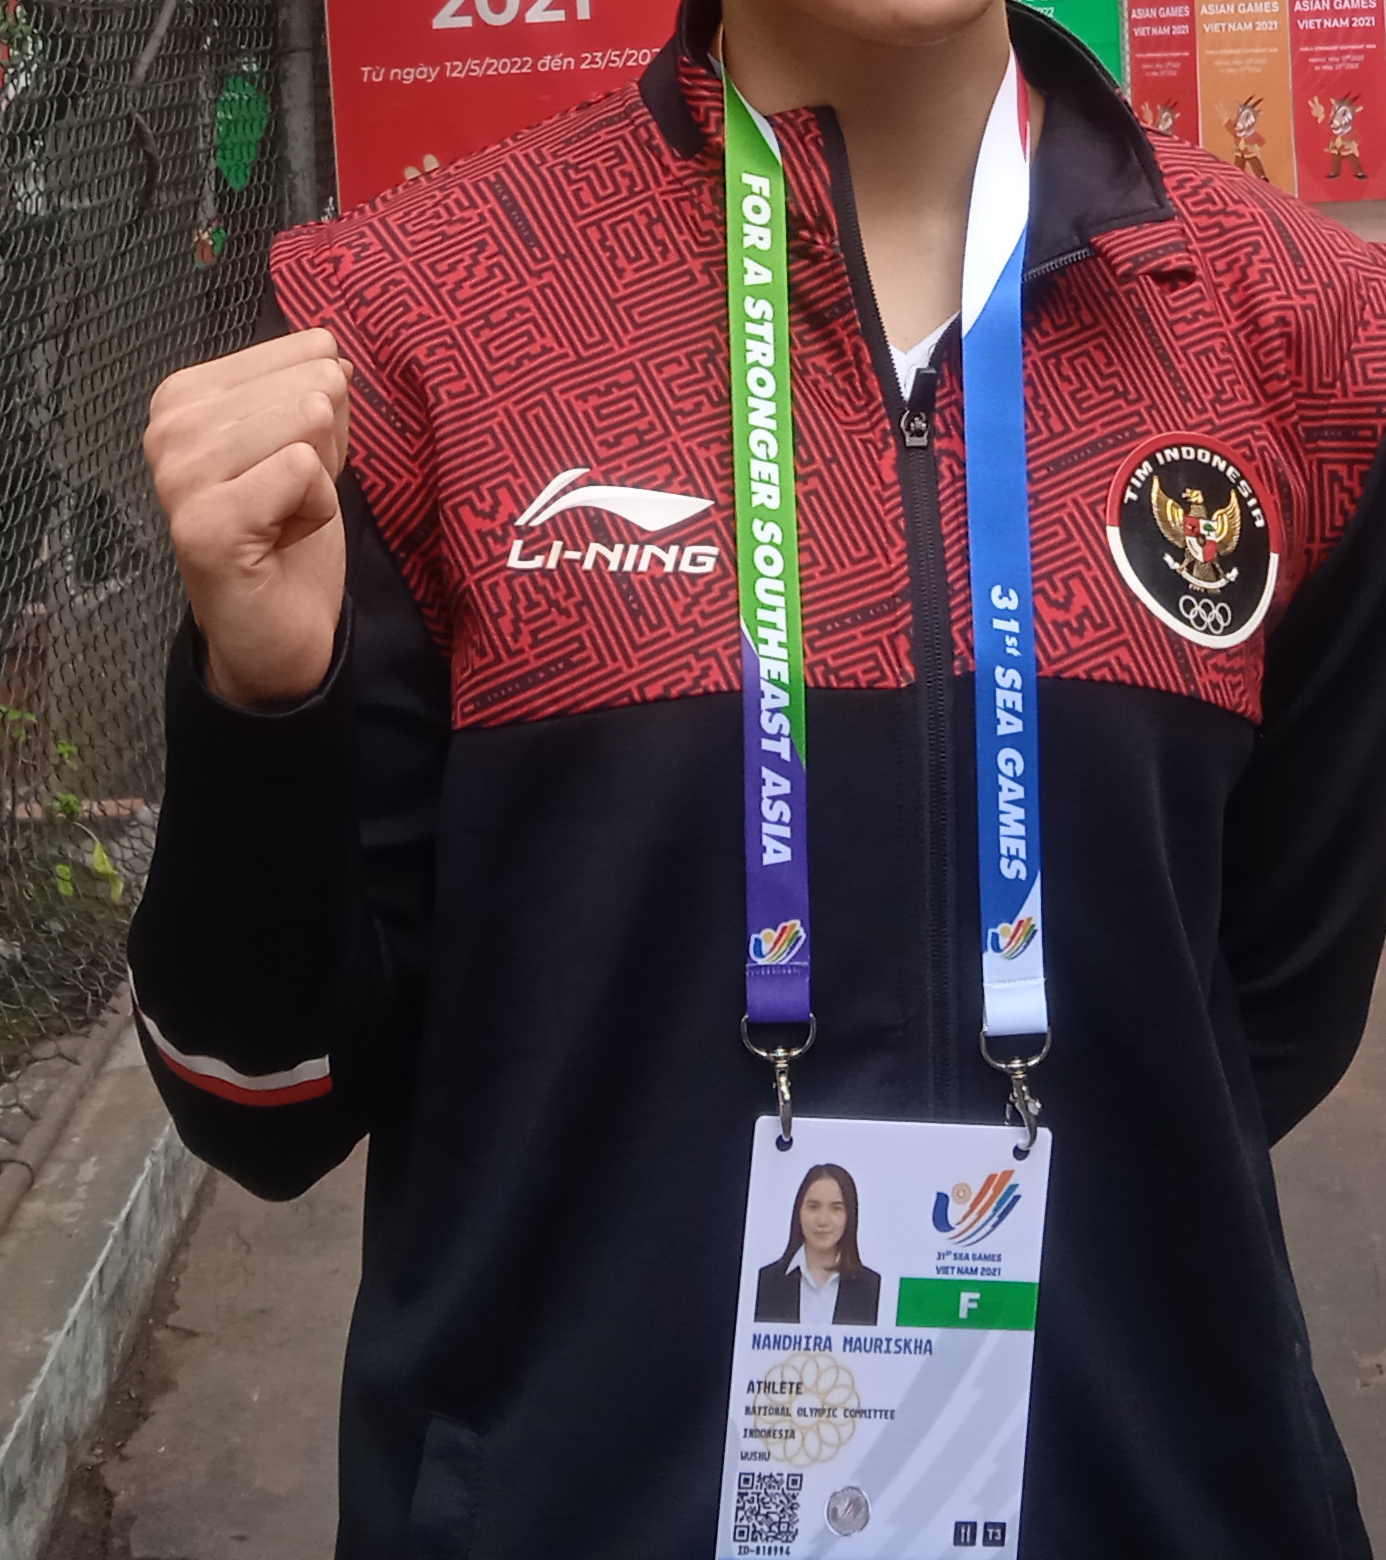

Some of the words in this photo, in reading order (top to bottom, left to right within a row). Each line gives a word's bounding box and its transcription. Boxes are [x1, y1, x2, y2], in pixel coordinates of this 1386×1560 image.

[1131, 7, 1157, 19] ASIAN
[1158, 5, 1190, 18] GAMES
[1200, 3, 1235, 15] ASIAN
[1237, 1, 1279, 14] GAMES
[1294, 0, 1330, 12] ASIAN
[1228, 21, 1253, 32] NAM
[1255, 20, 1278, 31] 2021
[1297, 19, 1321, 30] VIET
[1323, 17, 1349, 28] NAM
[1351, 16, 1376, 27] 2021
[361, 65, 384, 83] Từ
[390, 65, 440, 84] ngày
[445, 56, 533, 80] 12/5/2022
[537, 53, 575, 73] đến
[580, 47, 661, 70] 23/5/20
[740, 172, 772, 252] FOR
[743, 258, 773, 287] A
[743, 296, 781, 510] STRONGER
[1124, 461, 1154, 505] TIM
[1155, 446, 1266, 528] INDONESIA
[506, 540, 720, 574] LI-NING
[752, 520, 791, 761] SOUTHEAST
[994, 664, 1022, 736] SEA
[761, 765, 792, 867] ASIA
[996, 747, 1028, 881] GAMES
[953, 1252, 970, 1262] SEA
[935, 1265, 956, 1276] VIET
[957, 1266, 979, 1276] NAM
[980, 1266, 1002, 1277] 2021
[958, 1292, 981, 1318] F
[752, 1333, 833, 1353] NANDHIRA
[842, 1336, 933, 1355] MAURISKHA
[747, 1380, 803, 1395] ATHLETE
[744, 1405, 792, 1417] NATIONAL
[797, 1407, 838, 1419] OLYMPIC
[843, 1408, 896, 1420] COMMITTEE
[742, 1428, 796, 1440] INDONESIA
[740, 1451, 771, 1462] WUSHU
